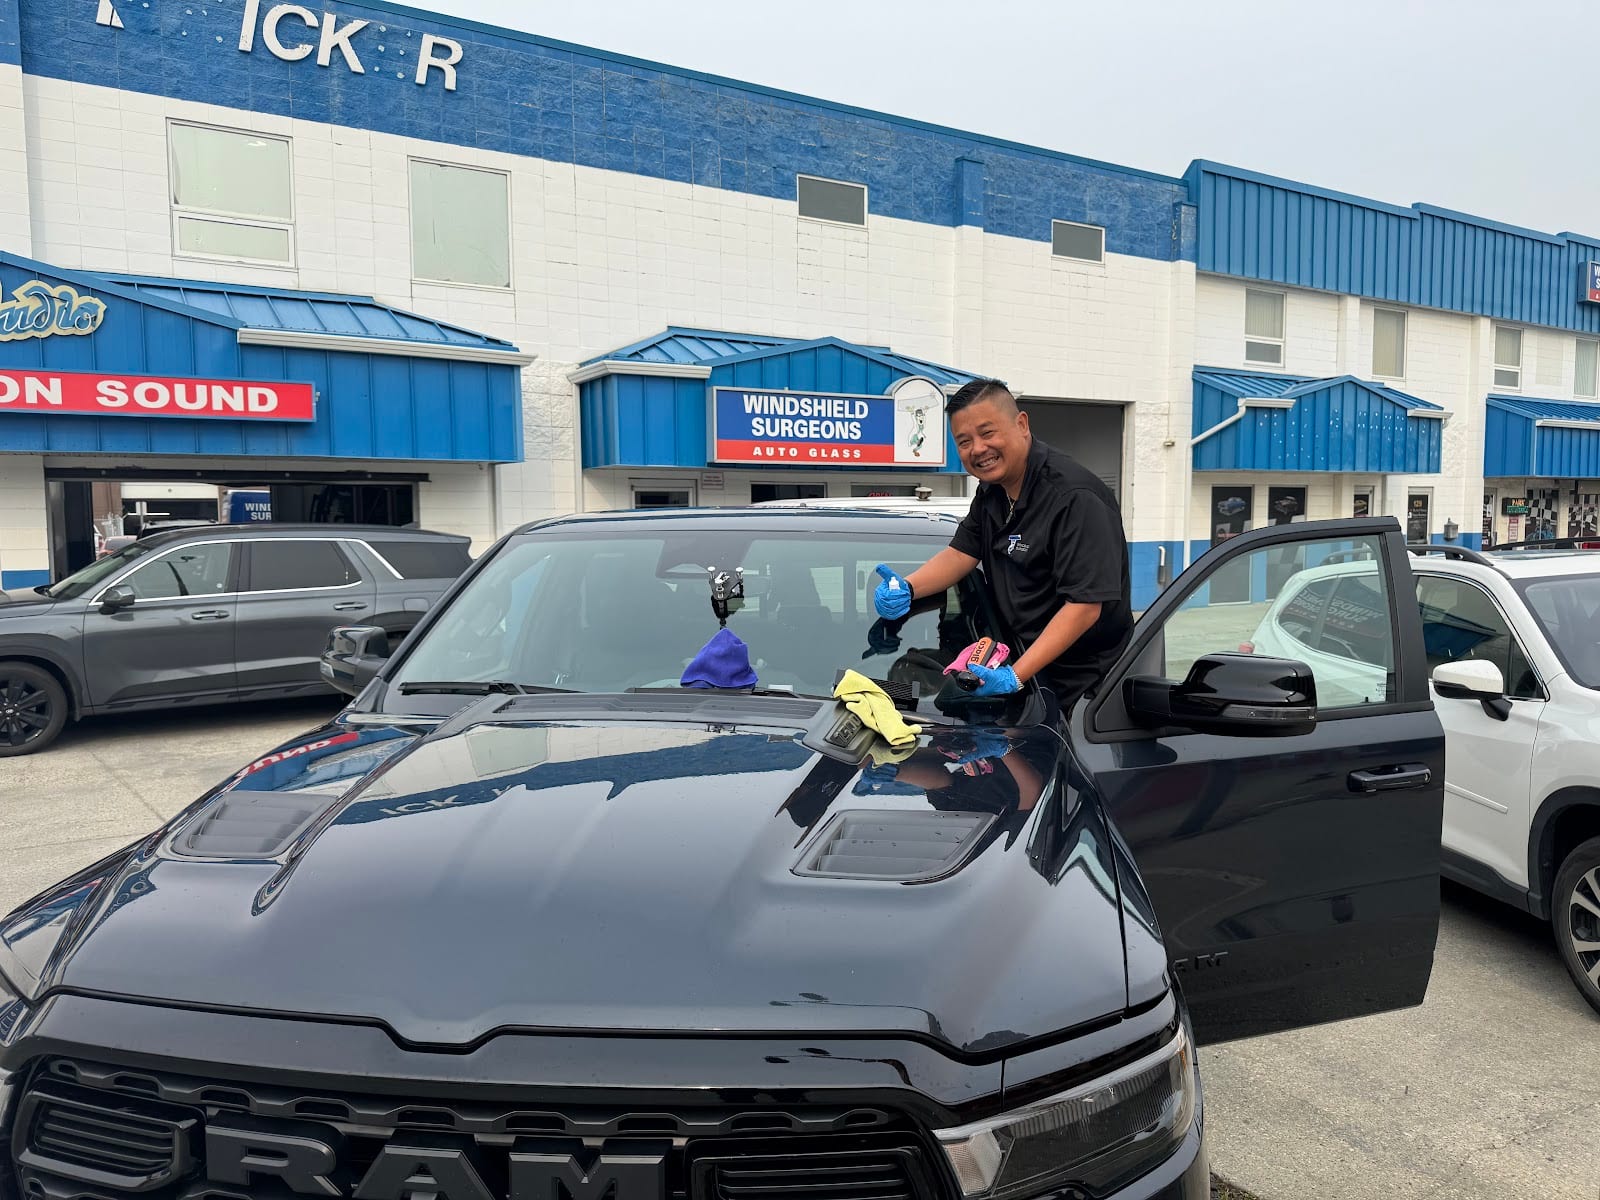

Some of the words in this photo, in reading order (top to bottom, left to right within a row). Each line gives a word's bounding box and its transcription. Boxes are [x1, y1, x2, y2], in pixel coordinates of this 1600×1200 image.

[0, 375, 63, 405] ON
[96, 380, 279, 413] SOUND
[743, 394, 869, 419] WINDSHIELD
[751, 417, 862, 440] SURGEONS
[752, 446, 798, 457] AUTO
[808, 447, 862, 459] GLASS
[204, 1114, 668, 1200] RAM
